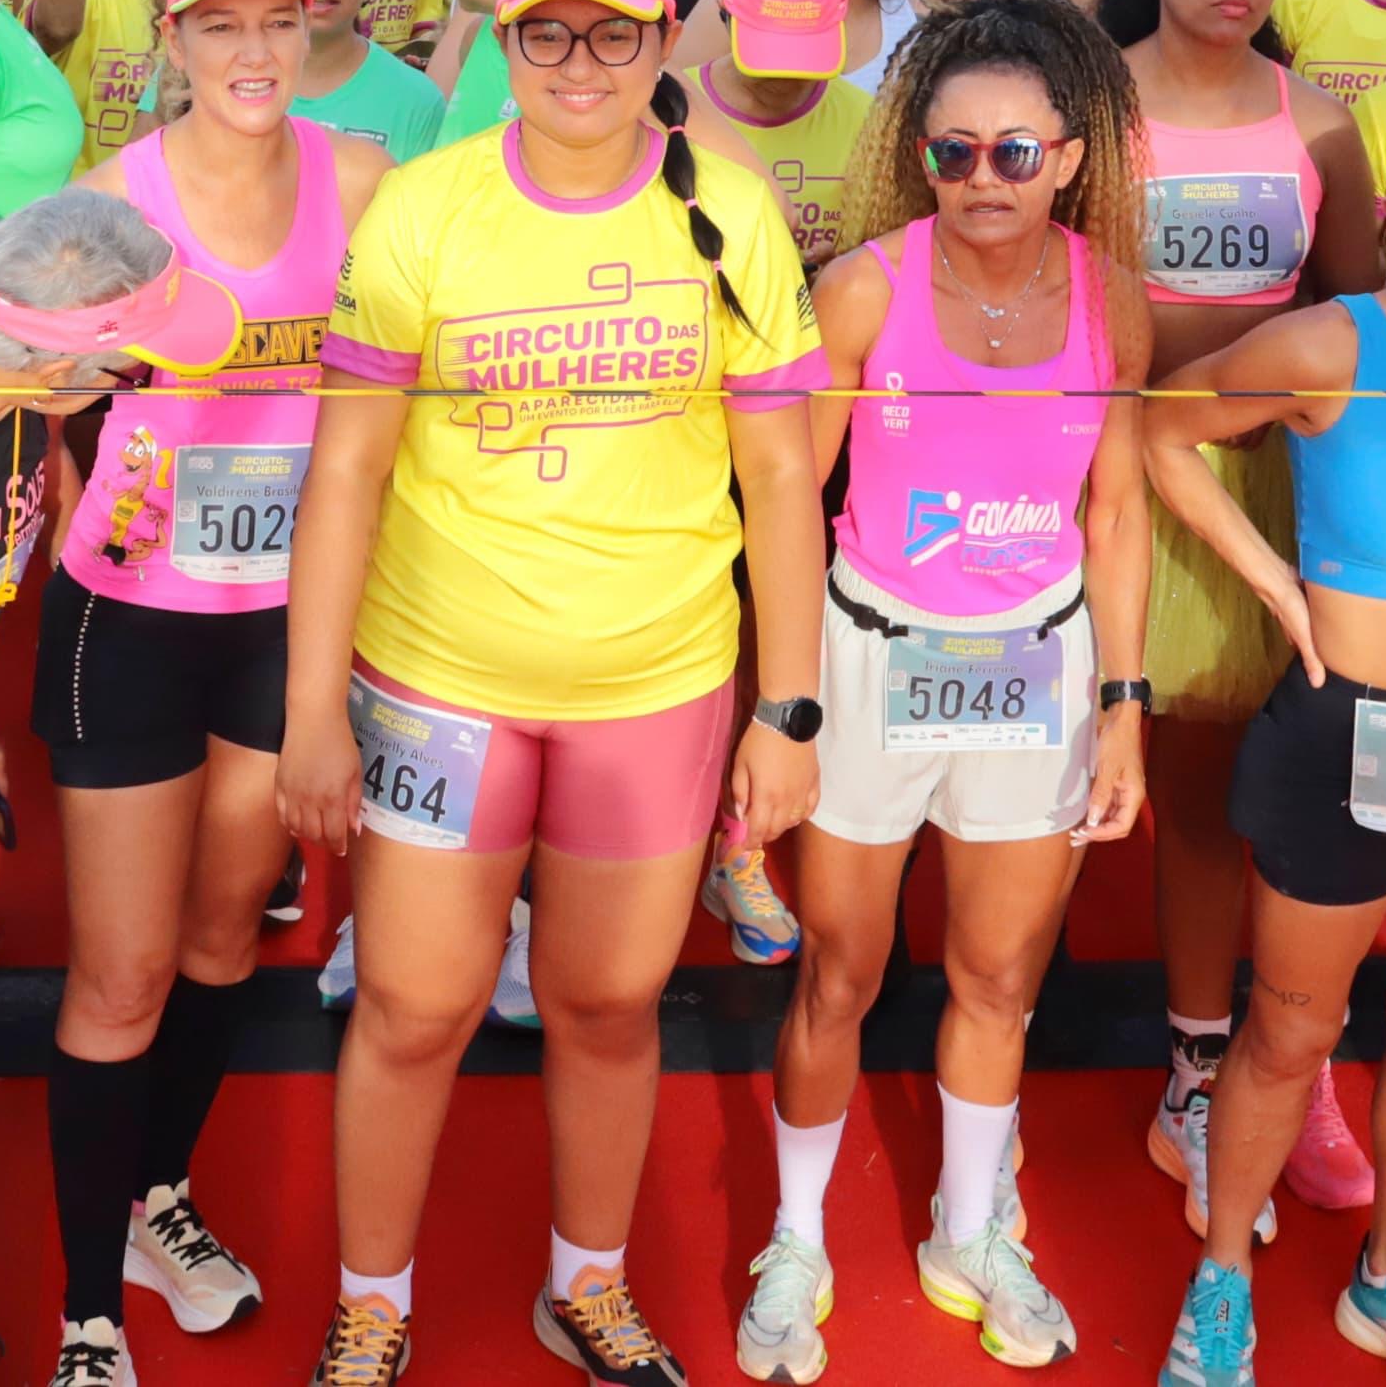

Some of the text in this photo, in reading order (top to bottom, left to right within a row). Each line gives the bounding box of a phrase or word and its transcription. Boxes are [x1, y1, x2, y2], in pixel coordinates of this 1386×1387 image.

[1163, 224, 1270, 269] 5269
[467, 316, 699, 363] CIRCUITO DAS
[468, 348, 699, 391] MULHERES
[176, 377, 278, 401] RUNNING
[519, 413, 534, 423] UM
[537, 410, 577, 421] EVENTO
[580, 408, 600, 418] POR
[603, 405, 629, 416] ELAS
[882, 405, 910, 417] RECO
[883, 418, 910, 430] VERY
[230, 464, 292, 475] MULHERES
[232, 456, 284, 466] CIRCUITO
[197, 484, 260, 498] Valdirene
[942, 644, 1005, 656] MULHERES
[944, 637, 997, 647] CIRCUITO
[908, 676, 1026, 721] 5048
[373, 711, 431, 742] MULHERES
[374, 702, 423, 727] CIRCUITO
[356, 722, 445, 770] Andryelly Alves
[356, 735, 448, 824] 464
